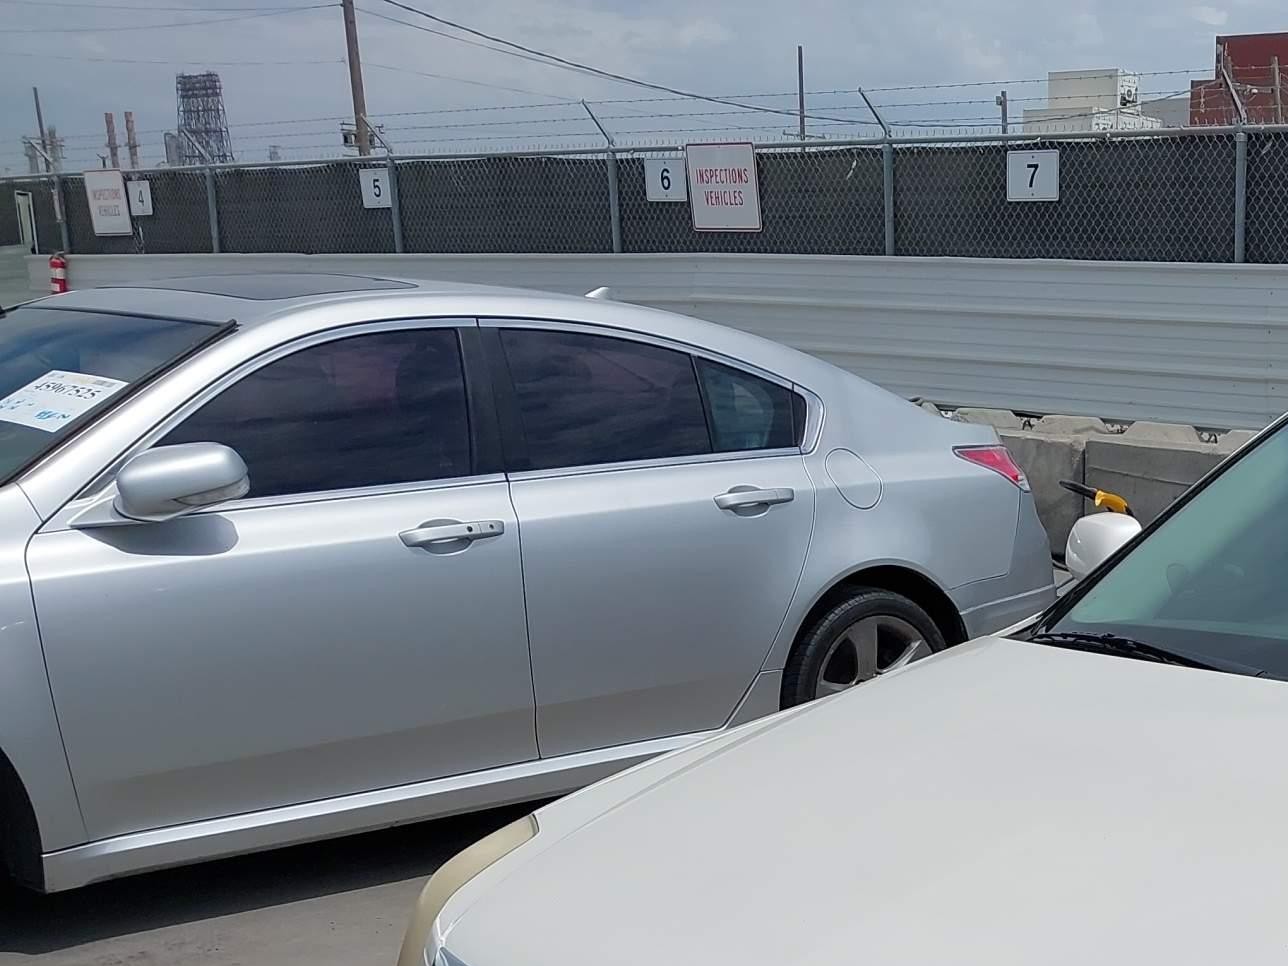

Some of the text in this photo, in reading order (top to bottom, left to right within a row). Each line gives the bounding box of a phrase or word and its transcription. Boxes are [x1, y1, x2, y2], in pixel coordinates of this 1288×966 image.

[660, 168, 671, 190] 6
[695, 168, 749, 184] INSPECTIONS
[1026, 163, 1039, 188] 7
[372, 178, 382, 198] 5
[138, 189, 145, 206] 4
[704, 190, 744, 206] VEHICLES
